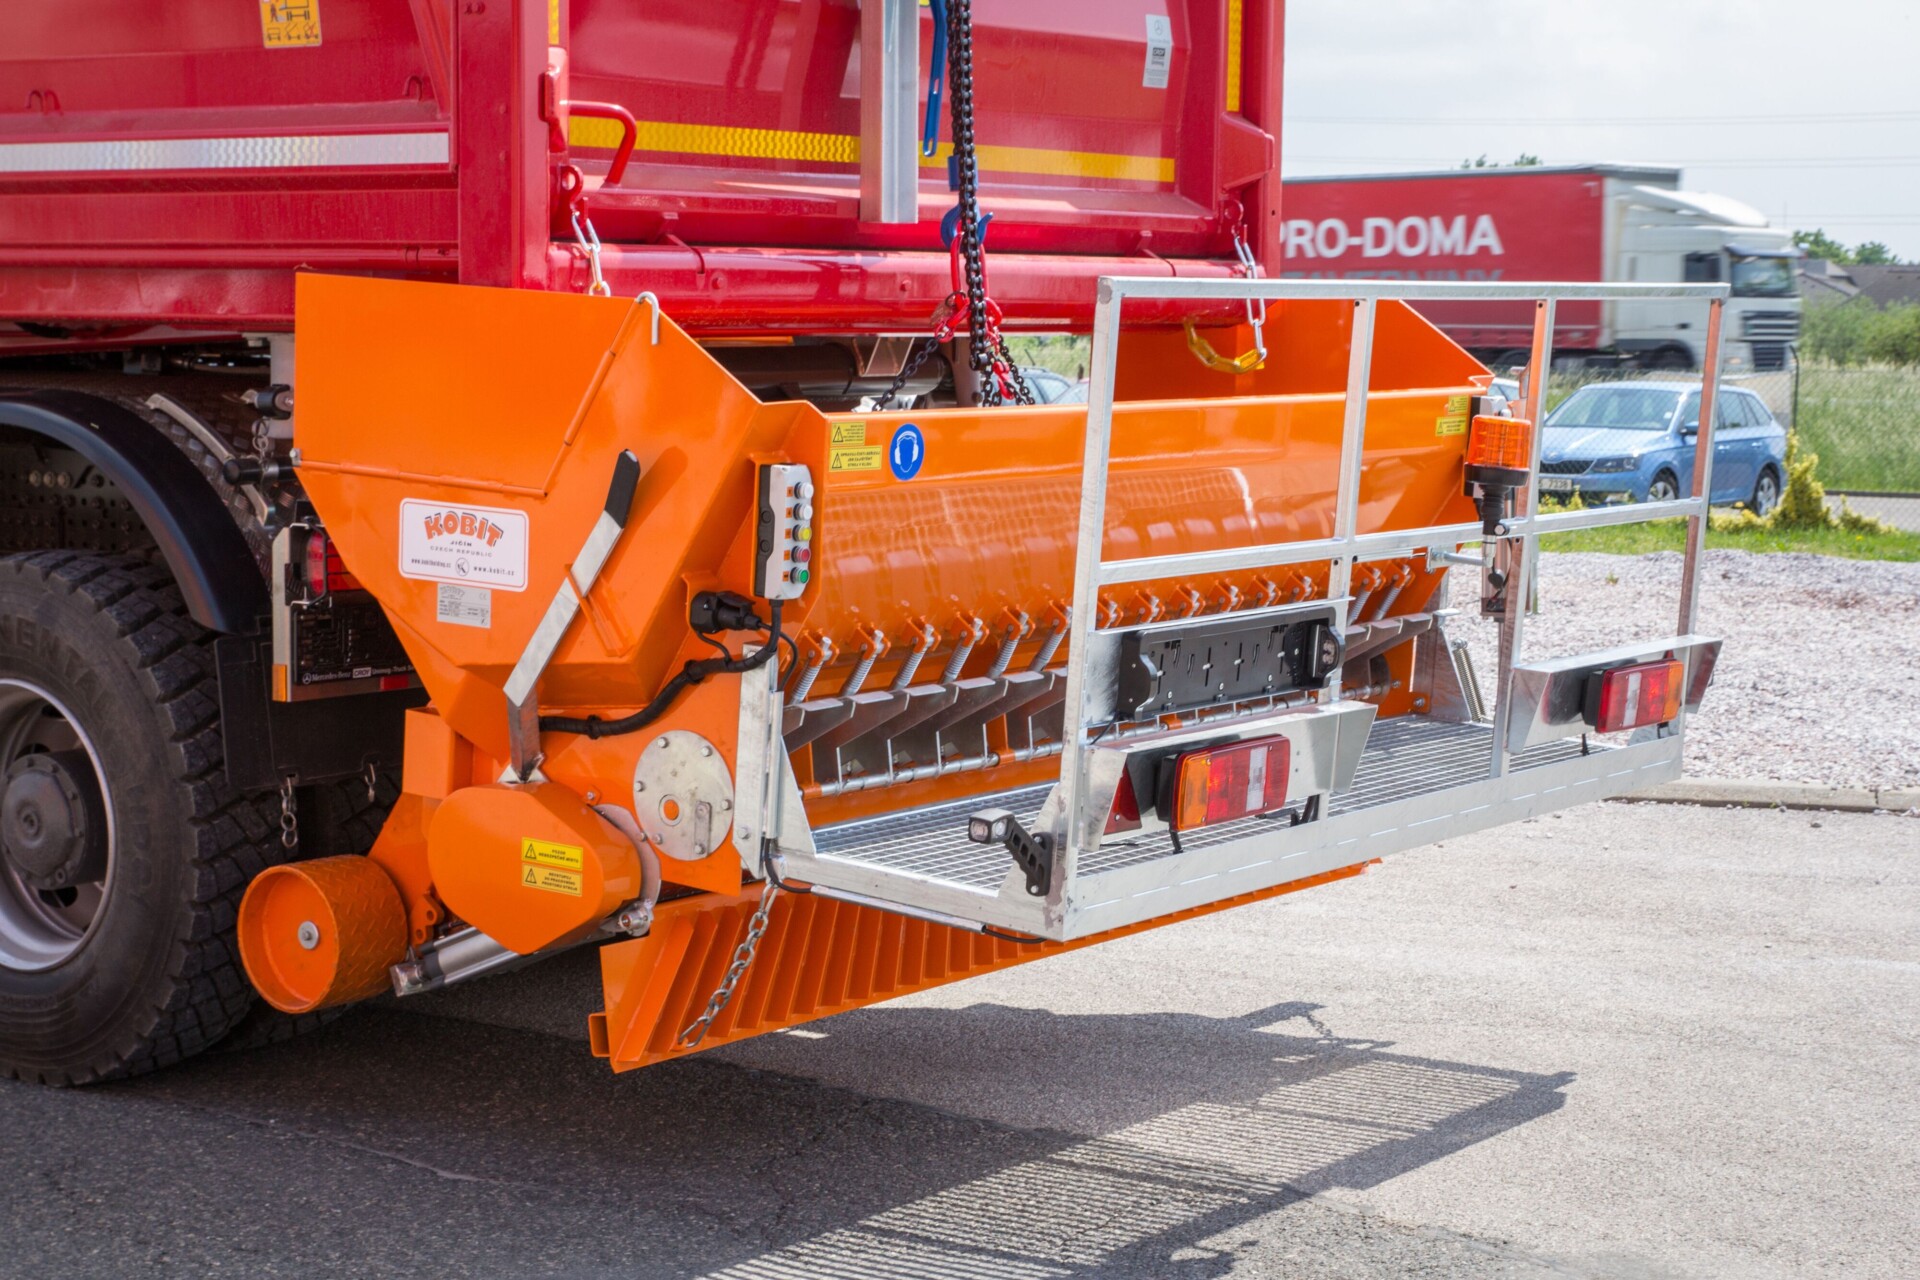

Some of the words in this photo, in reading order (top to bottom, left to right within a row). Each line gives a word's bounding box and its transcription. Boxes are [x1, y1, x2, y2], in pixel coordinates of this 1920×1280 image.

[1280, 214, 1504, 259] RO-DOMA
[424, 511, 504, 547] KOBIT
[456, 548, 493, 558] REPUBLIC
